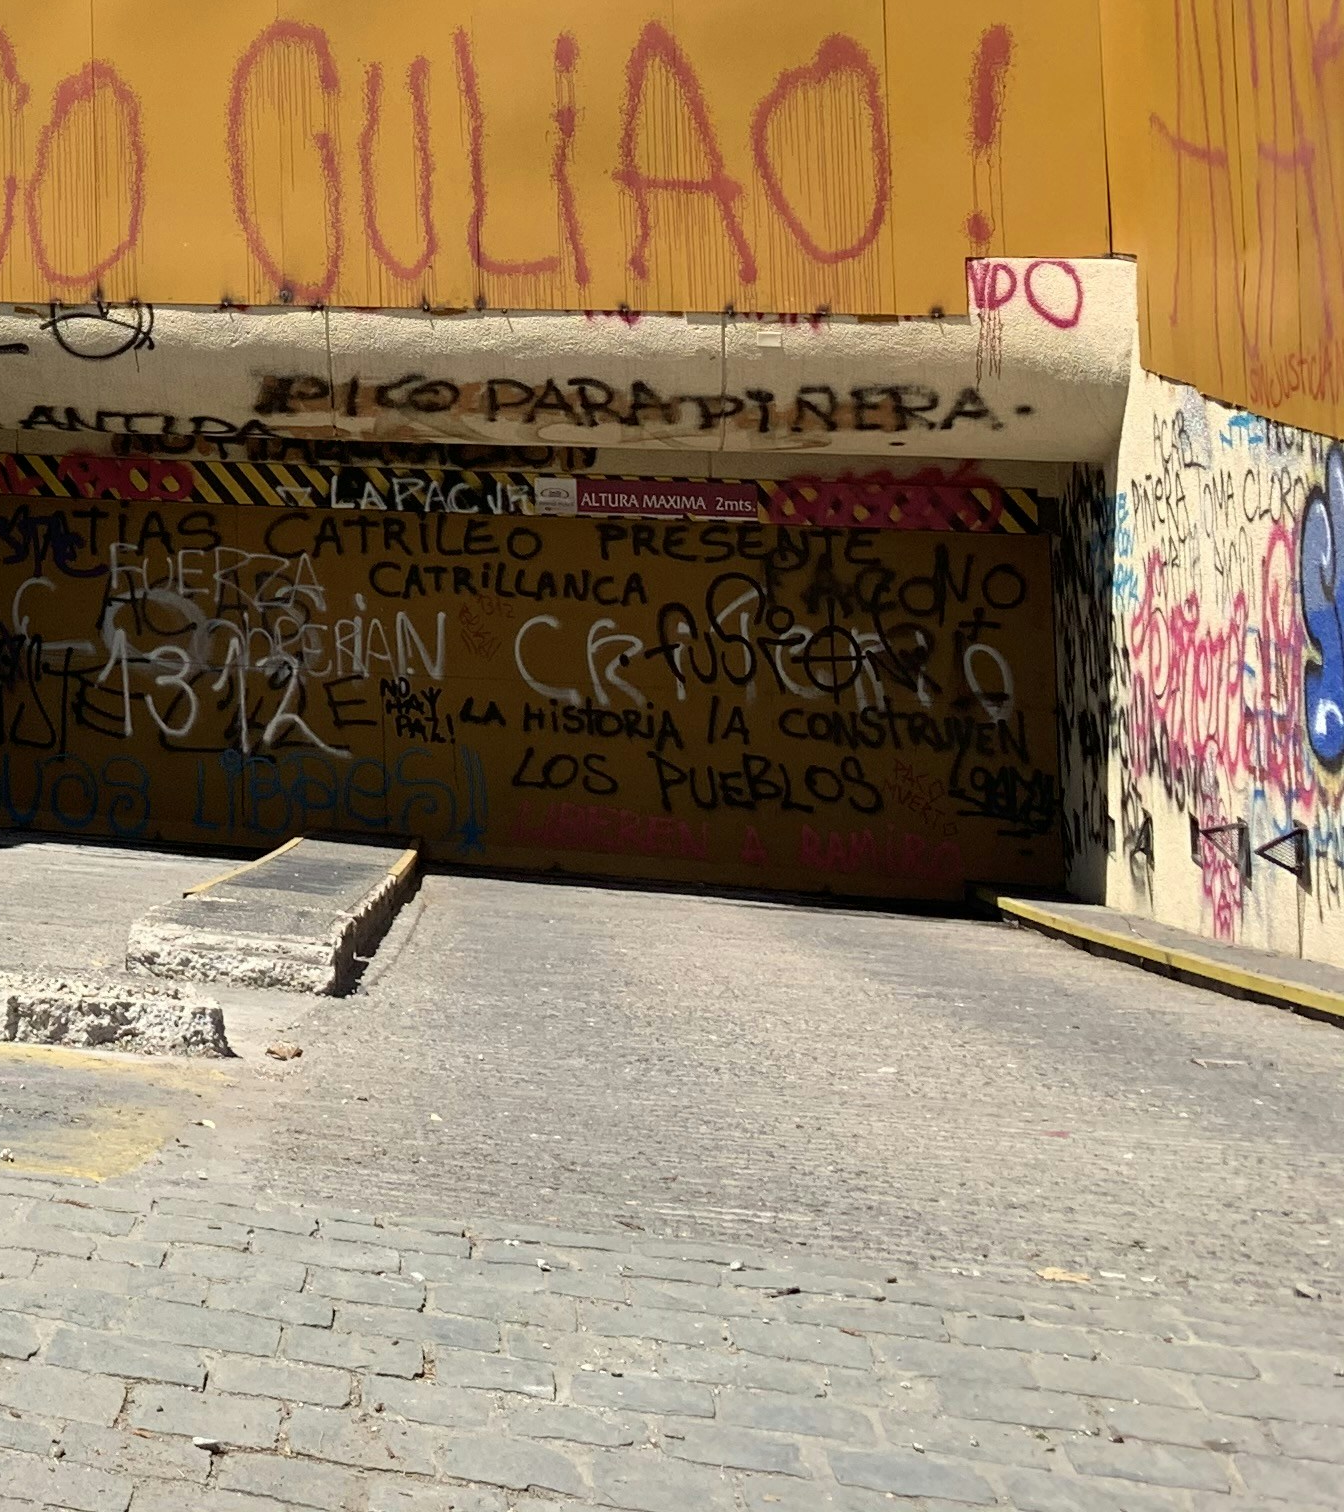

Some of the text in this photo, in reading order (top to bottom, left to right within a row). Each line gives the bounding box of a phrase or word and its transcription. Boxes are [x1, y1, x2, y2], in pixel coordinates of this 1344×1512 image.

[485, 376, 684, 432] PARA
[580, 491, 639, 509] ALTURA
[642, 493, 707, 511] MAXIMA
[714, 496, 757, 513] 2mts.
[110, 543, 326, 613] FUERZA
[97, 629, 352, 759] 1312
[380, 677, 410, 699] NO
[461, 697, 506, 726] LA
[512, 746, 620, 796] LOS
[646, 750, 884, 815] PUEBLOS
